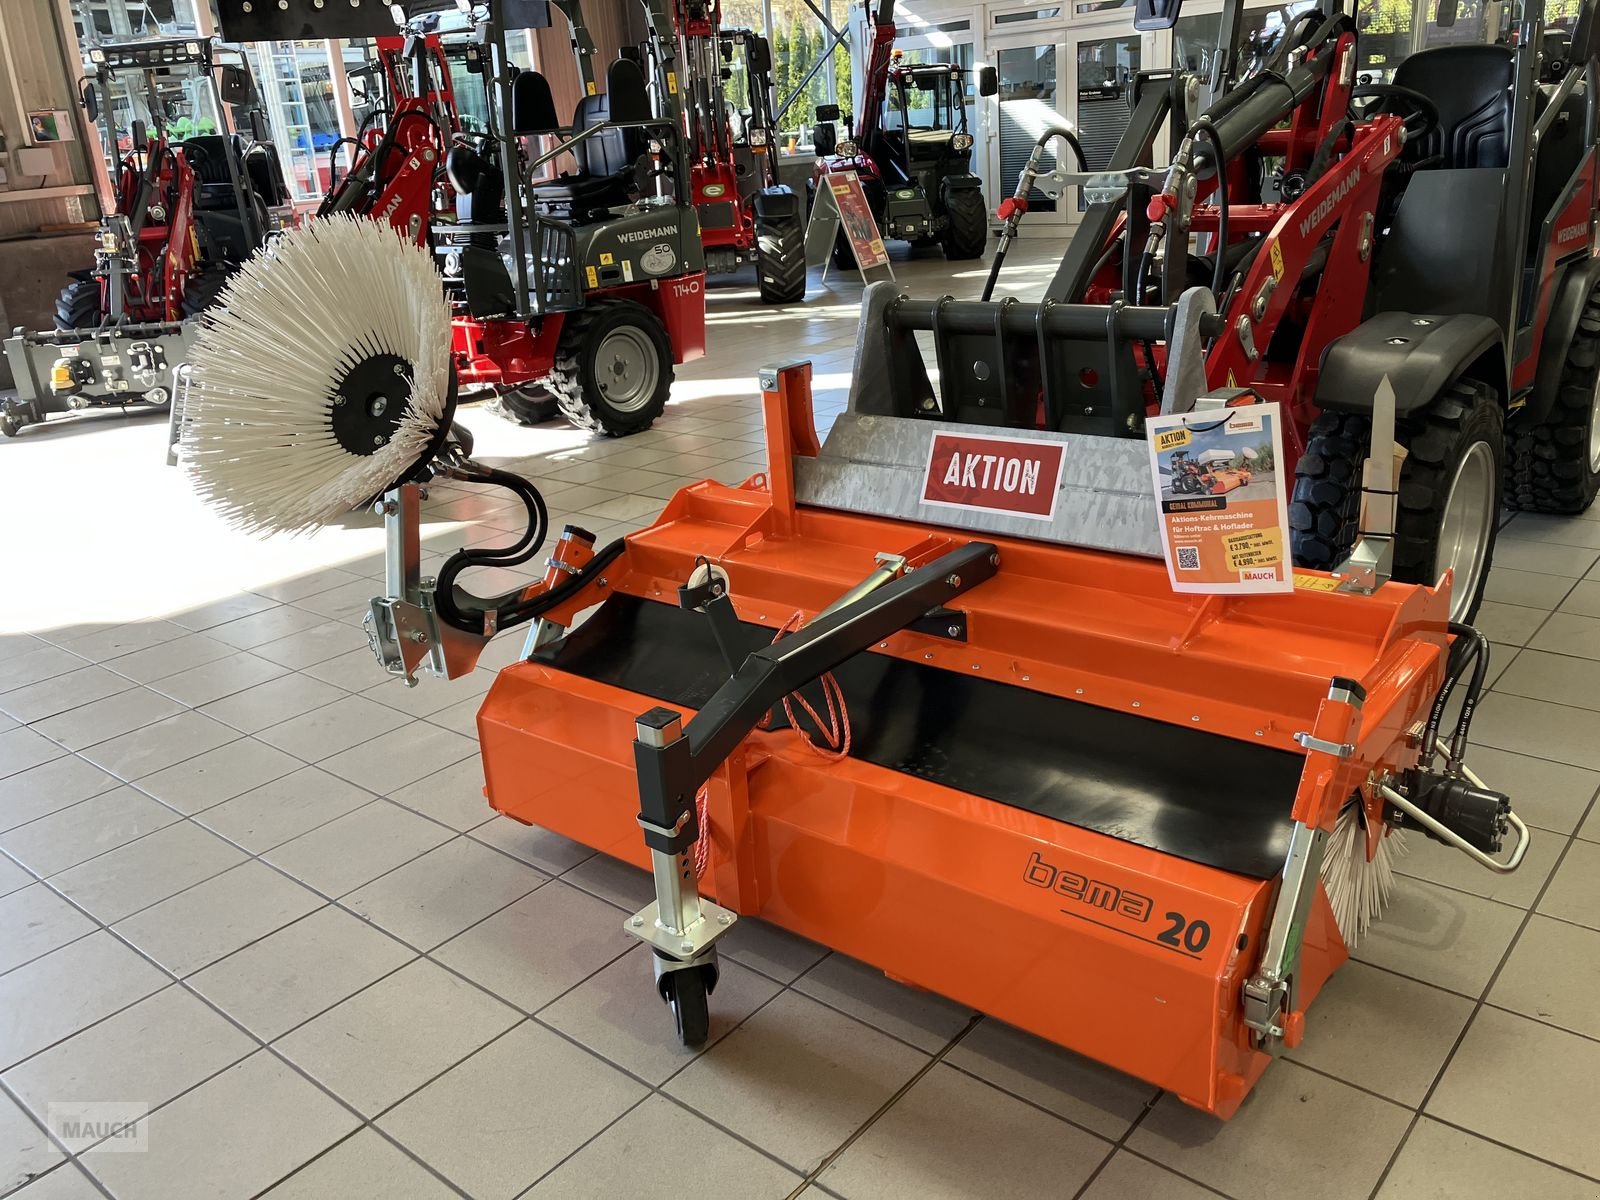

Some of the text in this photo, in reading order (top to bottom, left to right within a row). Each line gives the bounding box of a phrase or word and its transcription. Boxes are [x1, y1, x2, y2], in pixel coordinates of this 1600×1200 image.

[1300, 164, 1361, 238] WEIDEMANN
[617, 224, 678, 243] WEIDEMANN
[654, 244, 671, 255] 50
[673, 281, 699, 298] 1140
[1160, 430, 1186, 445] AKTION
[943, 452, 1041, 496] AKTION
[1171, 512, 1254, 523] Aktions-Kehrmaschine
[1220, 522, 1255, 530] Hoflader
[1244, 572, 1274, 580] MAUCH
[1023, 852, 1153, 923] bema
[1157, 912, 1211, 953] 20
